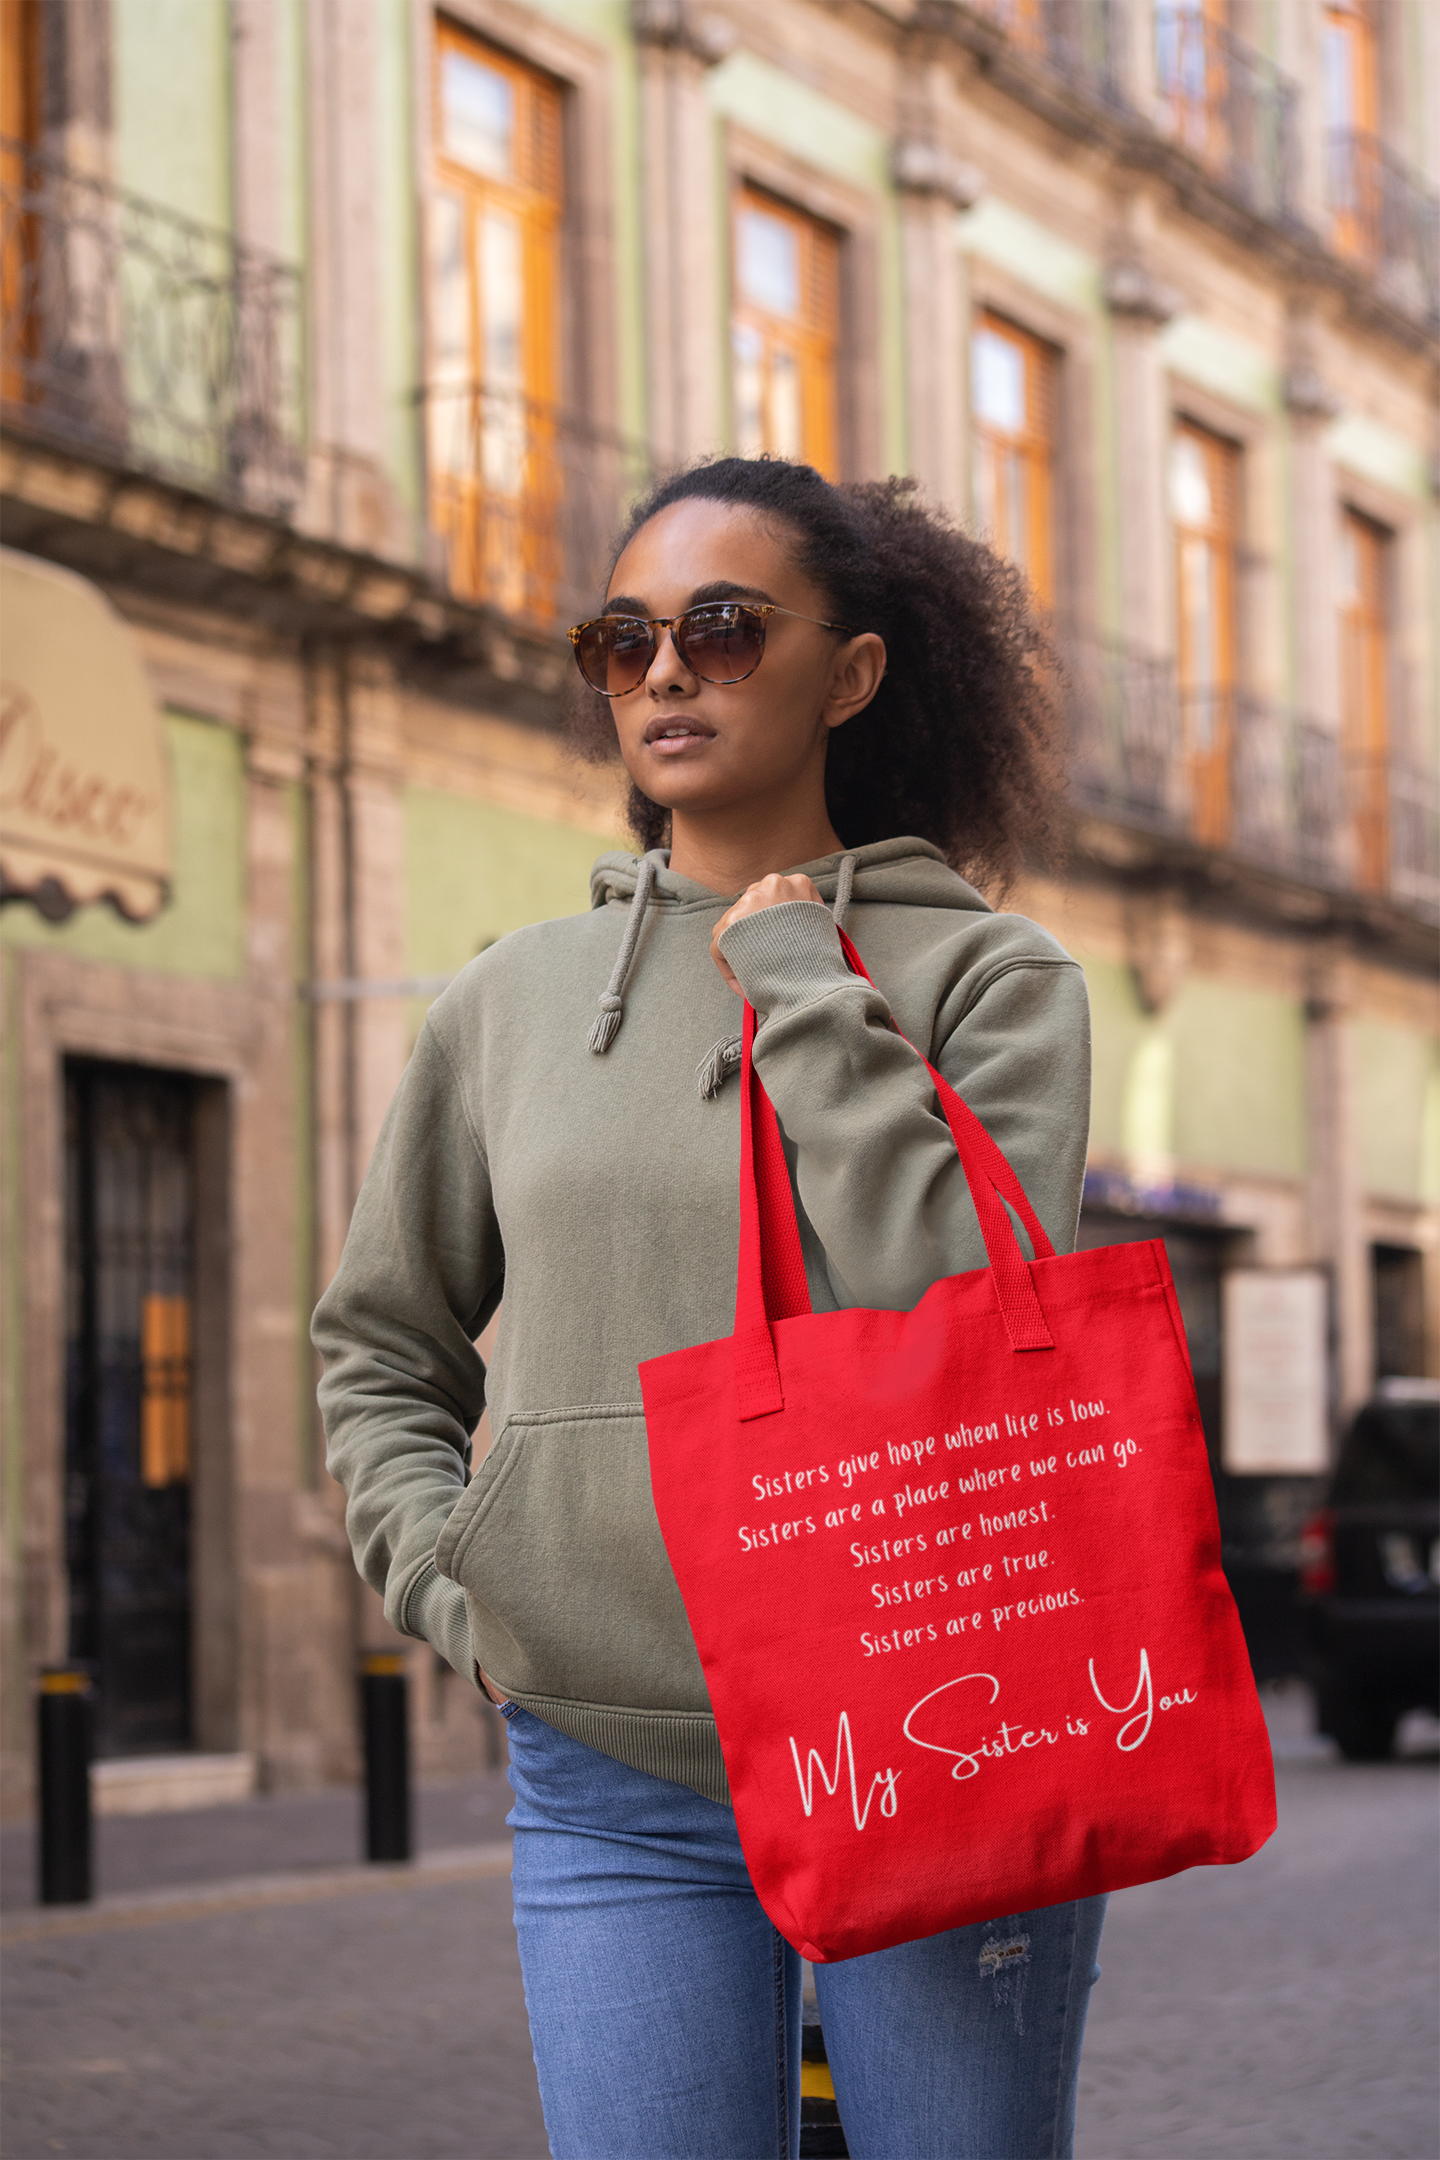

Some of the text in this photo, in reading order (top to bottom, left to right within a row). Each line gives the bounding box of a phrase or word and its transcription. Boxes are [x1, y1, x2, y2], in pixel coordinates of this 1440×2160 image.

[751, 1399, 1111, 1501] Sisters give hope when life is low.
[738, 1438, 1143, 1552] Sisters are a place where we can go.
[850, 1500, 1056, 1568] Sisters are honest.
[860, 1588, 1086, 1658] Sisters are precious.
[871, 1550, 1055, 1610] Sisters are true.
[788, 1648, 1199, 1831] My Sister is You
